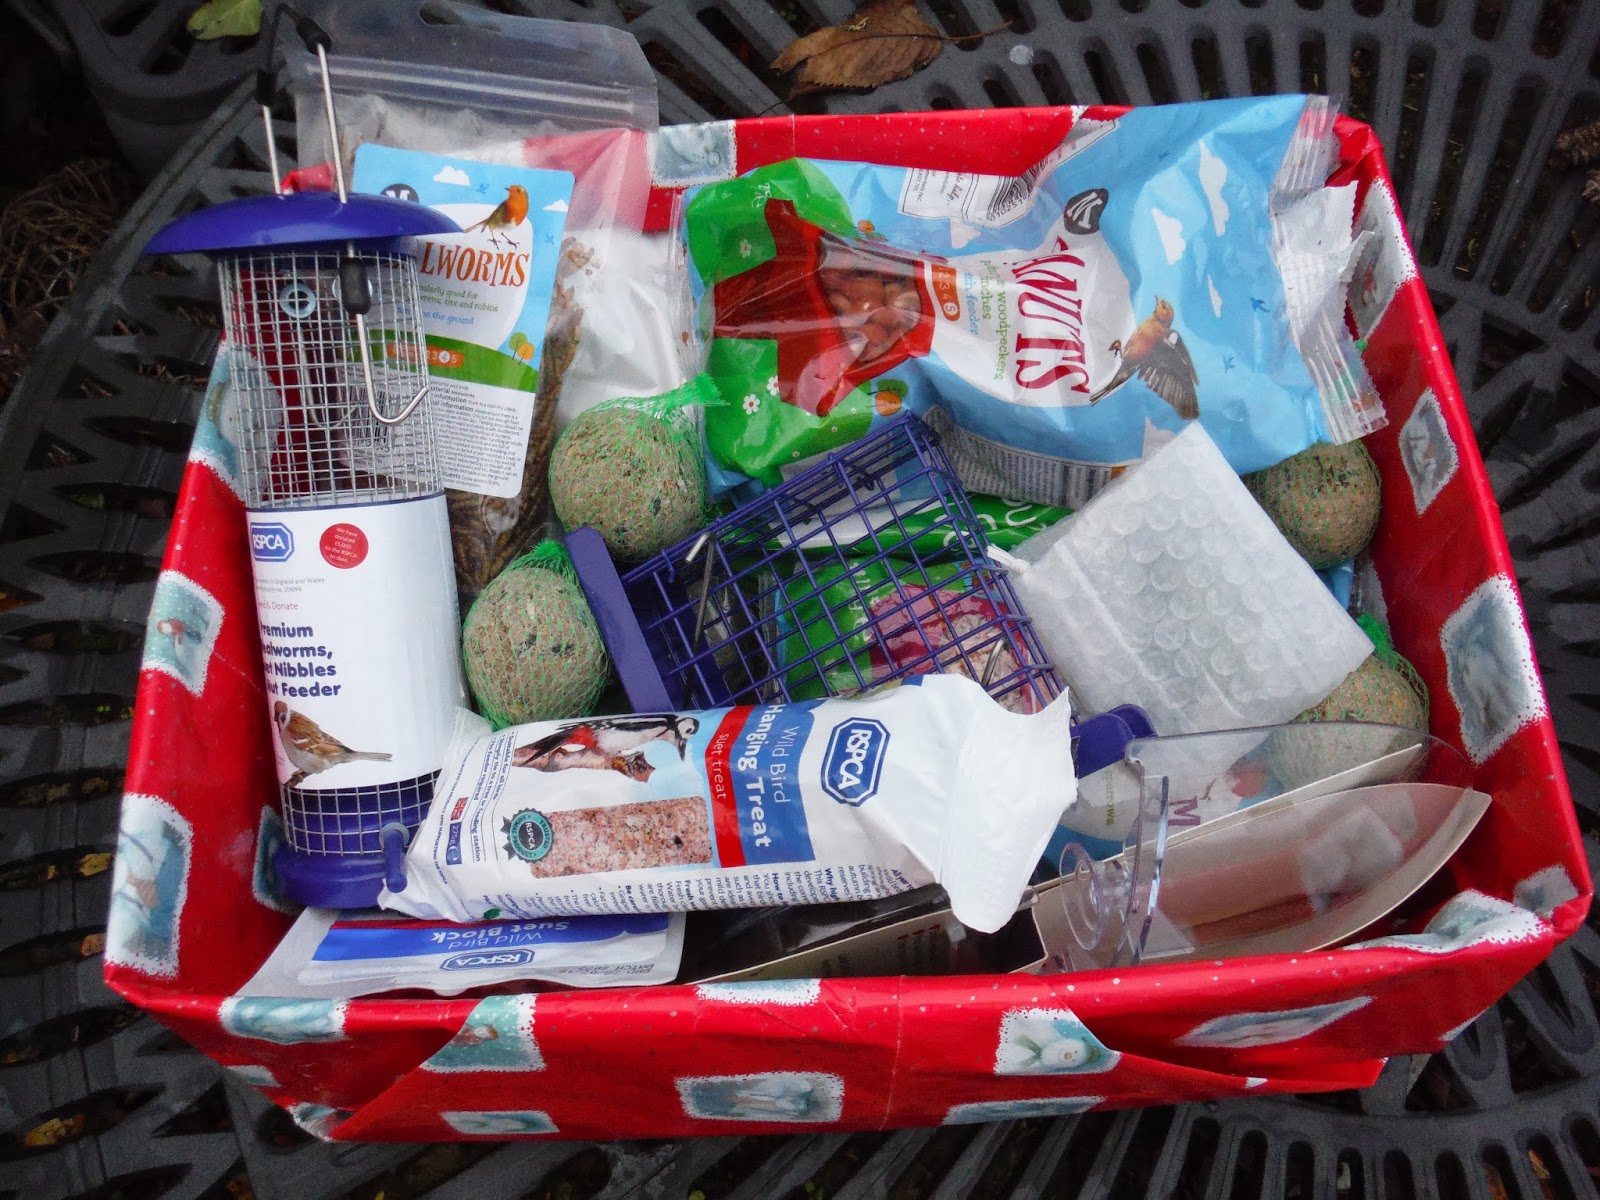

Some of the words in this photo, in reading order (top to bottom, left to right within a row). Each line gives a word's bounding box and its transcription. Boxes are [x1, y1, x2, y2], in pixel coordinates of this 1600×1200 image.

[420, 242, 530, 287] LWORMS
[263, 641, 333, 660] ealworms,
[274, 661, 337, 678] Nibbles
[281, 681, 342, 698] Feeder
[737, 704, 787, 772] Hanging
[772, 726, 799, 757] Wild
[837, 728, 873, 790] RSPCA
[711, 760, 727, 800] treat
[770, 763, 791, 803] Bird
[746, 776, 772, 848] Treat
[525, 822, 536, 849] RSPCA
[473, 834, 482, 862] station
[772, 872, 781, 892] How
[825, 867, 835, 886] Why
[431, 927, 503, 944] Block
[510, 921, 571, 932] Suet
[448, 937, 489, 950] Bird
[495, 932, 542, 945] Wild
[455, 952, 522, 967] RSPCA
